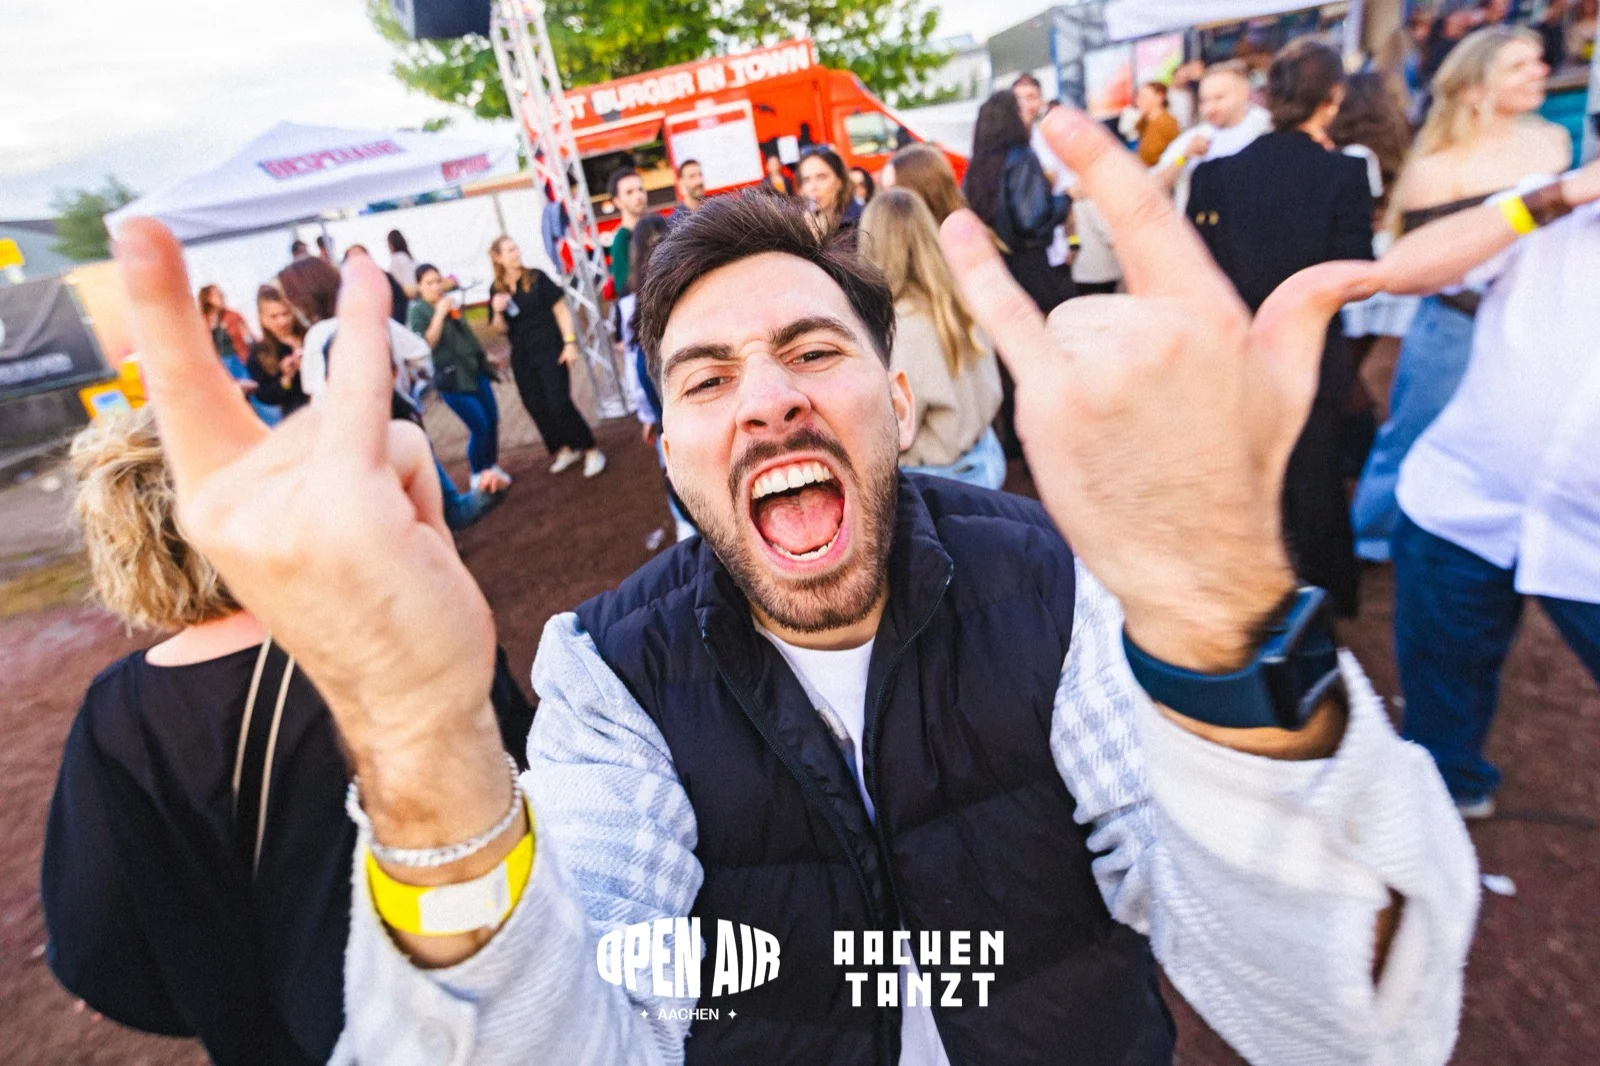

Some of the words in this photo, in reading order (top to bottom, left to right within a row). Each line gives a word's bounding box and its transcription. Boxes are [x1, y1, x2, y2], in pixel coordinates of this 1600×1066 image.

[591, 72, 695, 115] BURGER
[696, 64, 726, 94] IN
[727, 45, 810, 88] TOWN
